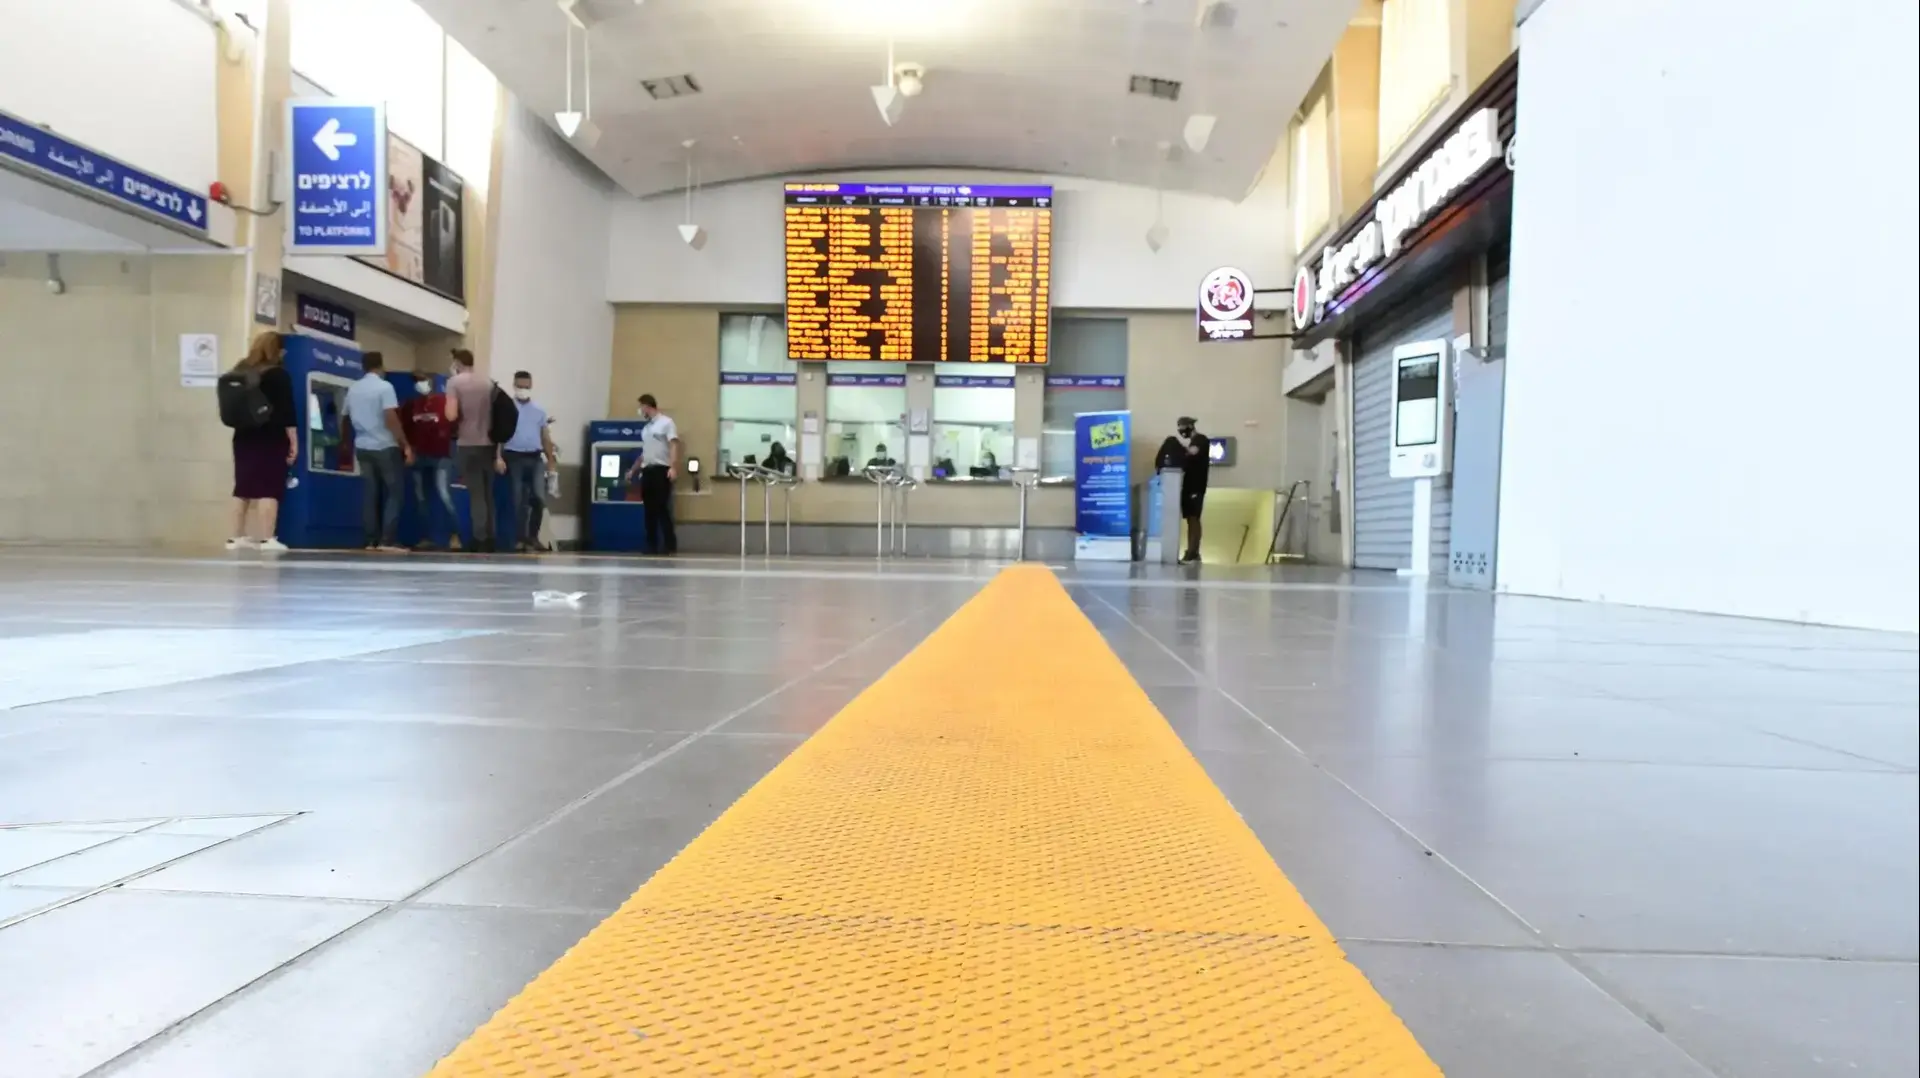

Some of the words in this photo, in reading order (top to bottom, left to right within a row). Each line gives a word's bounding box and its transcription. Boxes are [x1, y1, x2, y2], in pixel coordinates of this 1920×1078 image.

[298, 169, 371, 190] לרציפים
[122, 175, 183, 213] לרציפים
[298, 197, 347, 218] الأرصفة
[350, 199, 371, 219] إلى
[299, 225, 313, 237] TO
[313, 225, 371, 238] PLATFORMS
